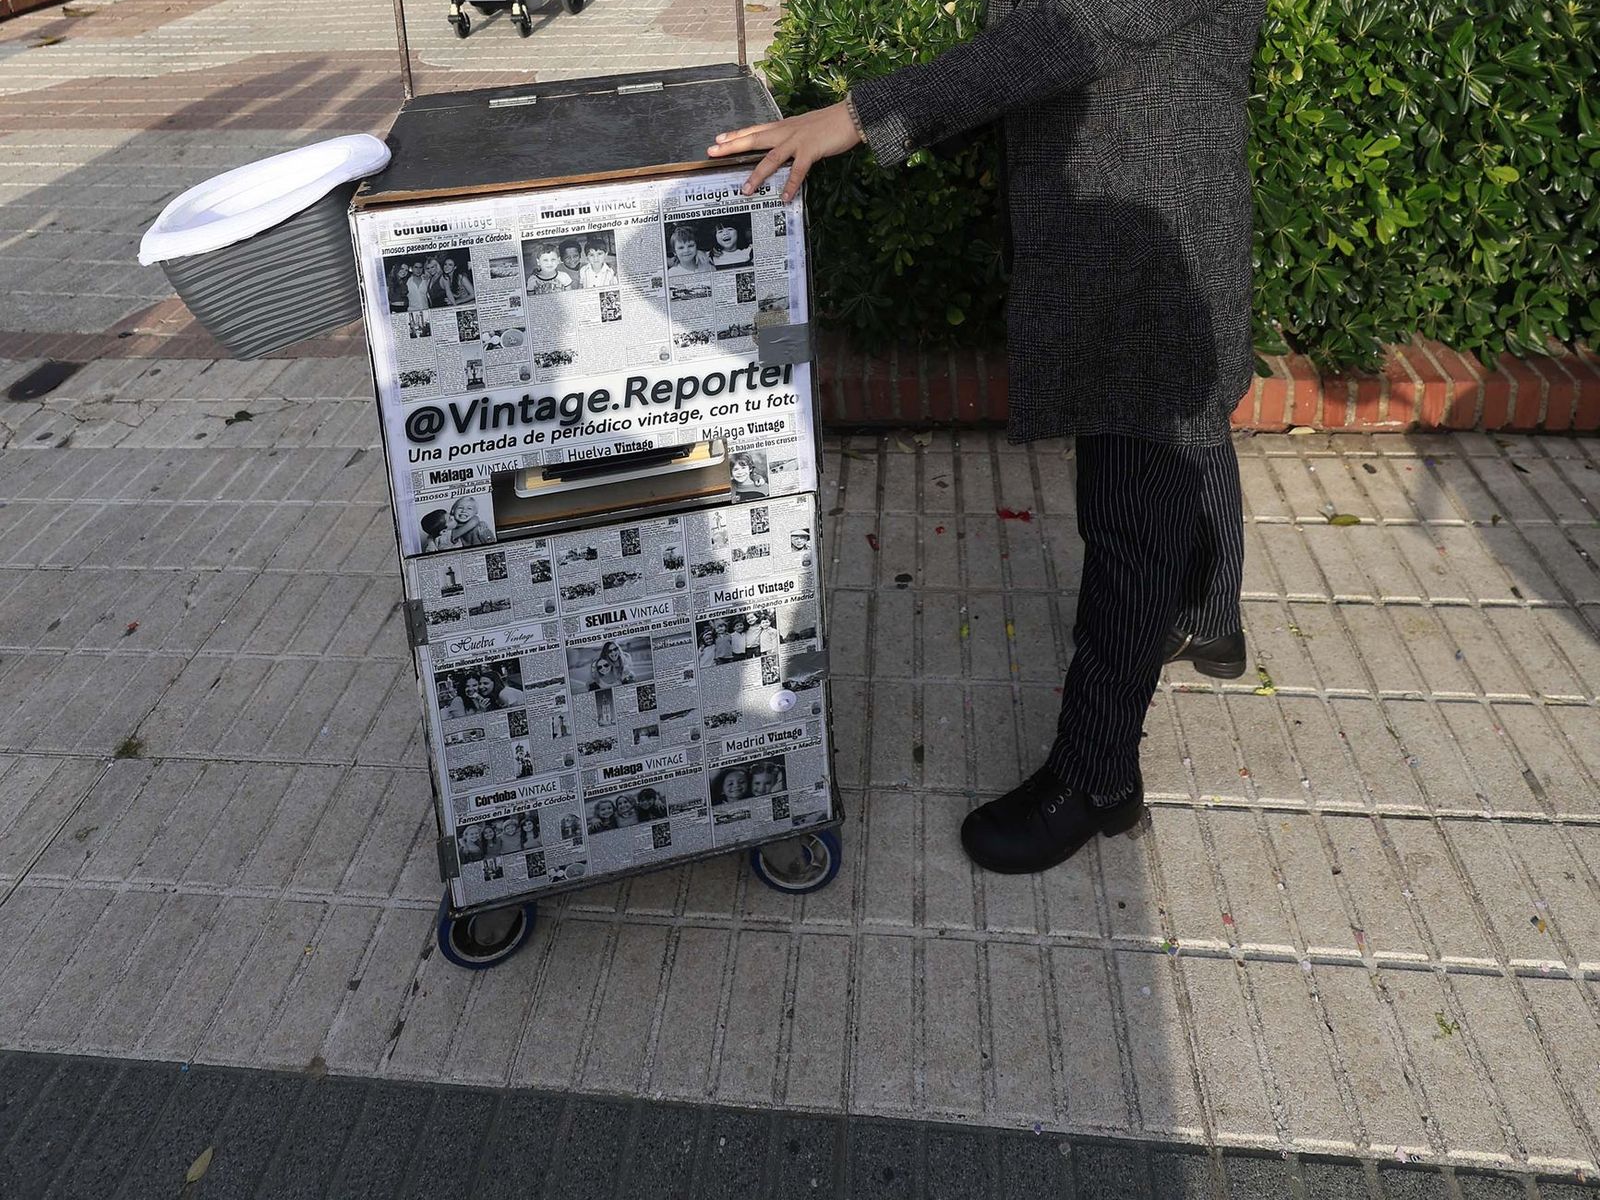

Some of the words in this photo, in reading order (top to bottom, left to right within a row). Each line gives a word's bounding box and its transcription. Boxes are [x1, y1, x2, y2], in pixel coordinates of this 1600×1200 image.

[663, 210, 701, 221] Famosos
[701, 204, 751, 217] vacacionan
[521, 230, 534, 238] Las
[536, 225, 569, 237] estrellas
[571, 225, 586, 233] van
[587, 219, 622, 231] llegando
[630, 214, 659, 225] Madrid
[382, 246, 405, 255] amosos
[406, 242, 437, 255] paseando
[438, 241, 450, 250] por
[451, 239, 457, 247] la
[459, 237, 475, 247] Feria
[475, 236, 484, 245] de
[484, 232, 512, 243] Córdoba
[408, 447, 442, 463] Una
[448, 434, 517, 460] portada
[523, 429, 545, 445] de
[550, 418, 632, 444] periódico
[637, 408, 703, 427] vintage,
[709, 403, 739, 417] con
[745, 399, 761, 411] tu
[767, 393, 799, 408] foto
[702, 425, 745, 441] Málaga
[747, 419, 785, 433] Vintage
[568, 443, 612, 462] Huelva
[614, 438, 654, 454] Vintage
[755, 441, 764, 449] de
[429, 467, 474, 485] Málaga
[414, 492, 449, 503] amosos
[451, 485, 486, 499] pillados
[714, 585, 755, 603] Madrid
[757, 580, 795, 595] Vintage
[585, 609, 628, 628] SEVILLA
[629, 602, 670, 619] VINTAGE
[695, 613, 708, 621] Las
[708, 609, 737, 619] estrellas
[752, 599, 783, 611] llegando
[789, 592, 815, 603] Madrid
[450, 635, 496, 654] Huelva
[503, 628, 535, 644] Vintage
[565, 635, 602, 647] Famosos
[602, 626, 650, 640] vacacionan
[662, 617, 690, 628] Sevilla
[434, 662, 454, 672] Turistas
[506, 650, 524, 658] Huelva
[538, 645, 546, 653] las
[546, 643, 560, 651] luces
[726, 734, 765, 752] Madrid
[767, 728, 803, 742] Vintage
[708, 761, 720, 769] Las
[798, 738, 821, 749] Madrid
[603, 762, 643, 780] Málaga
[645, 753, 684, 770] VINTAGE
[475, 790, 517, 808] Córdoba
[517, 780, 557, 798] VINTAGE
[618, 775, 663, 789] vacacionan
[458, 814, 491, 825] Famosos
[492, 810, 503, 818] en
[512, 804, 531, 814] Feria
[543, 793, 576, 807] Córdoba
